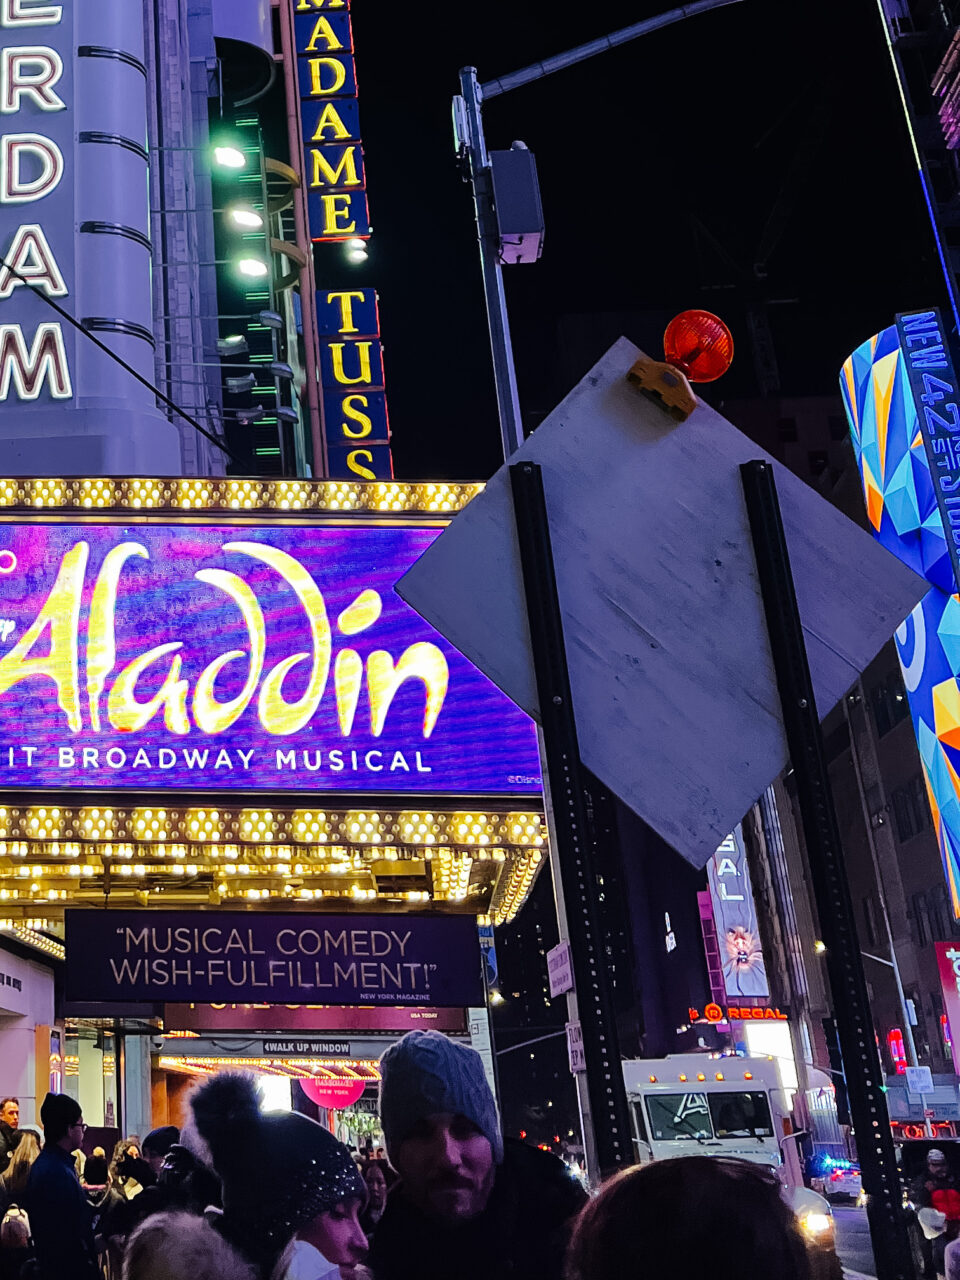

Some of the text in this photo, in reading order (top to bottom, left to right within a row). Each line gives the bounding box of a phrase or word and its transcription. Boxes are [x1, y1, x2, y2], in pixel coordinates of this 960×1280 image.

[901, 311, 949, 368] NEW
[920, 373, 960, 435] 42
[58, 746, 255, 770] BROADWAY
[276, 749, 432, 772] MUSICAL
[276, 928, 412, 958] COMEDY
[396, 993, 431, 1001] MAGAZINE
[727, 1007, 788, 1019] REGAL
[269, 1042, 350, 1053] WALK UP WINDOW
